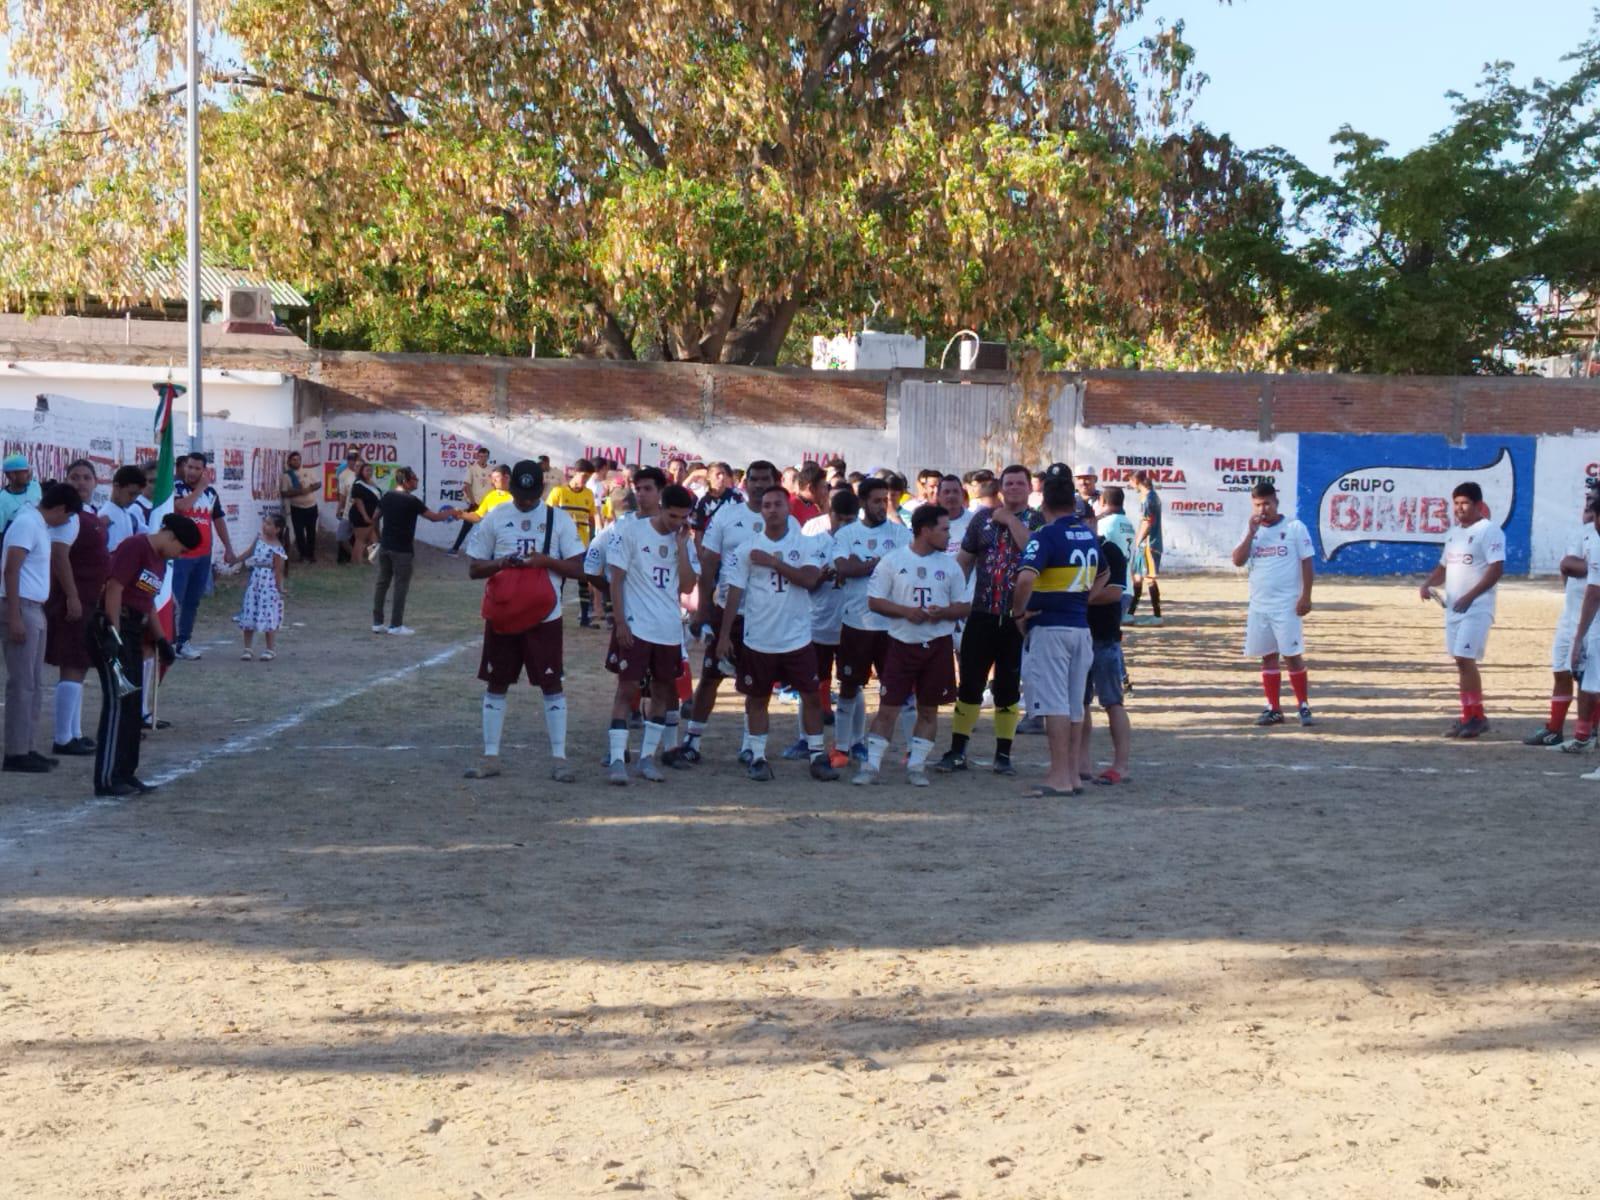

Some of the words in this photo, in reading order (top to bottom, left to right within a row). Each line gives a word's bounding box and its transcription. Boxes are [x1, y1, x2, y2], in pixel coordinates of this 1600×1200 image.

[327, 441, 398, 463] mrena
[1116, 455, 1174, 467] ENRIQUE
[1213, 457, 1284, 472] IMELDA
[1101, 467, 1187, 484] INZNZA
[1222, 474, 1276, 486] CASTRO
[1338, 478, 1396, 493] GRUPO
[1170, 500, 1225, 513] morena
[1067, 547, 1099, 592] 20
